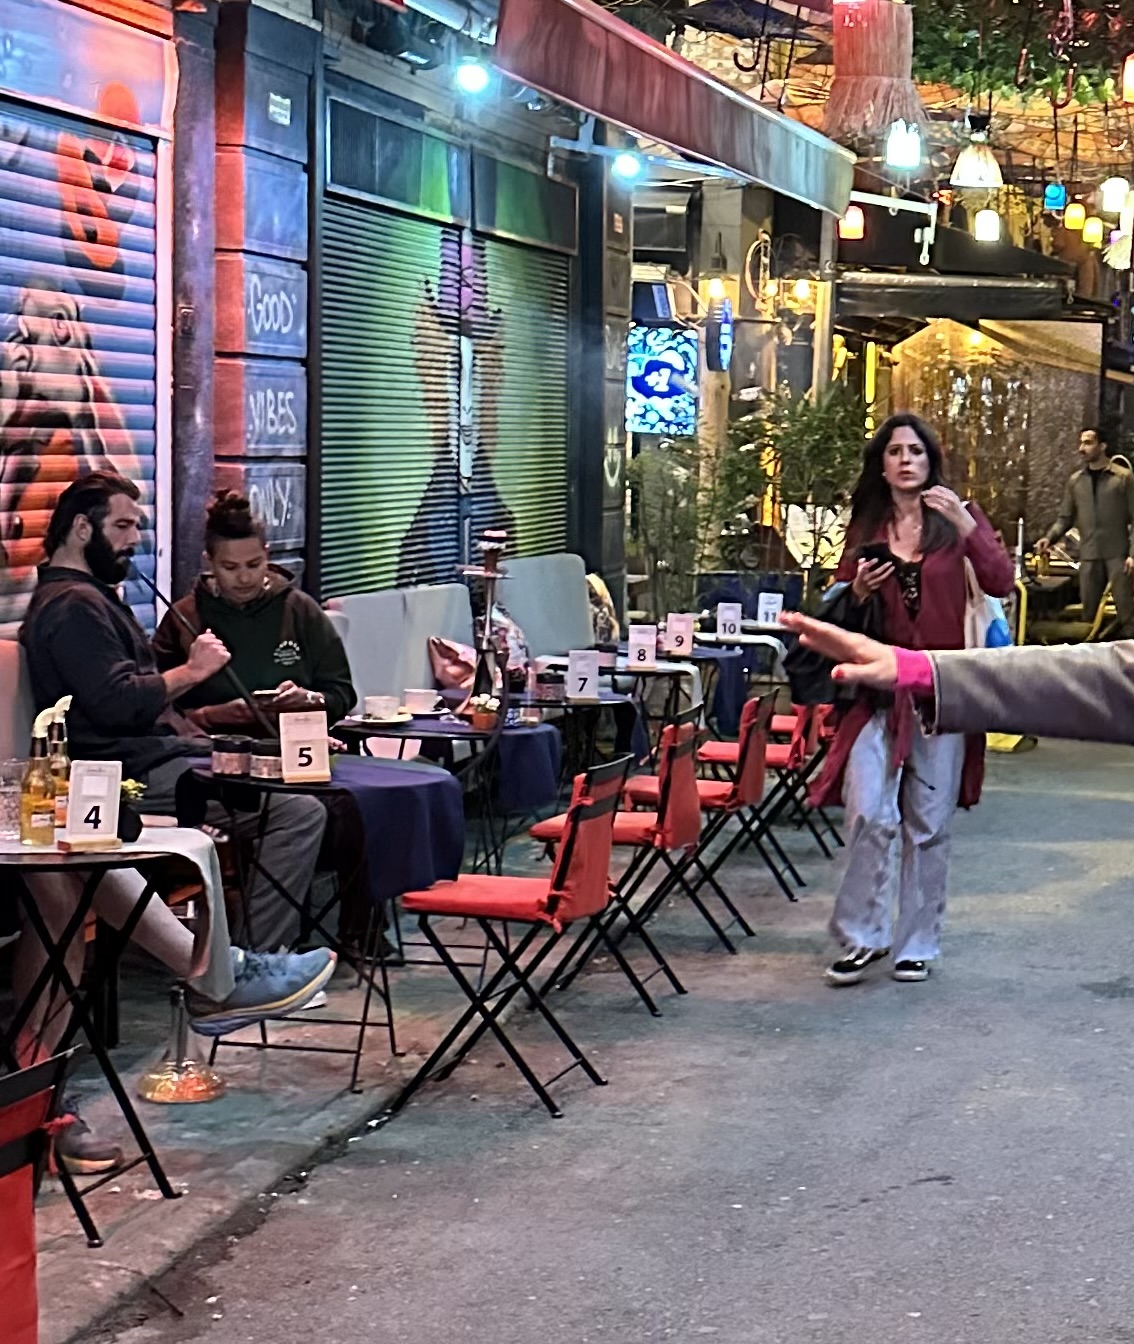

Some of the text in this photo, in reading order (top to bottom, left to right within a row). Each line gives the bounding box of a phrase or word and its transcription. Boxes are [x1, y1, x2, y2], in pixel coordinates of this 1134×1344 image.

[249, 273, 295, 334] GOOD
[249, 388, 298, 435] VIBES
[721, 622, 737, 635] 10
[675, 635, 684, 647] 9
[637, 648, 647, 662] 8
[577, 677, 589, 693] 7
[297, 746, 313, 768] 5
[83, 805, 102, 830] 4
